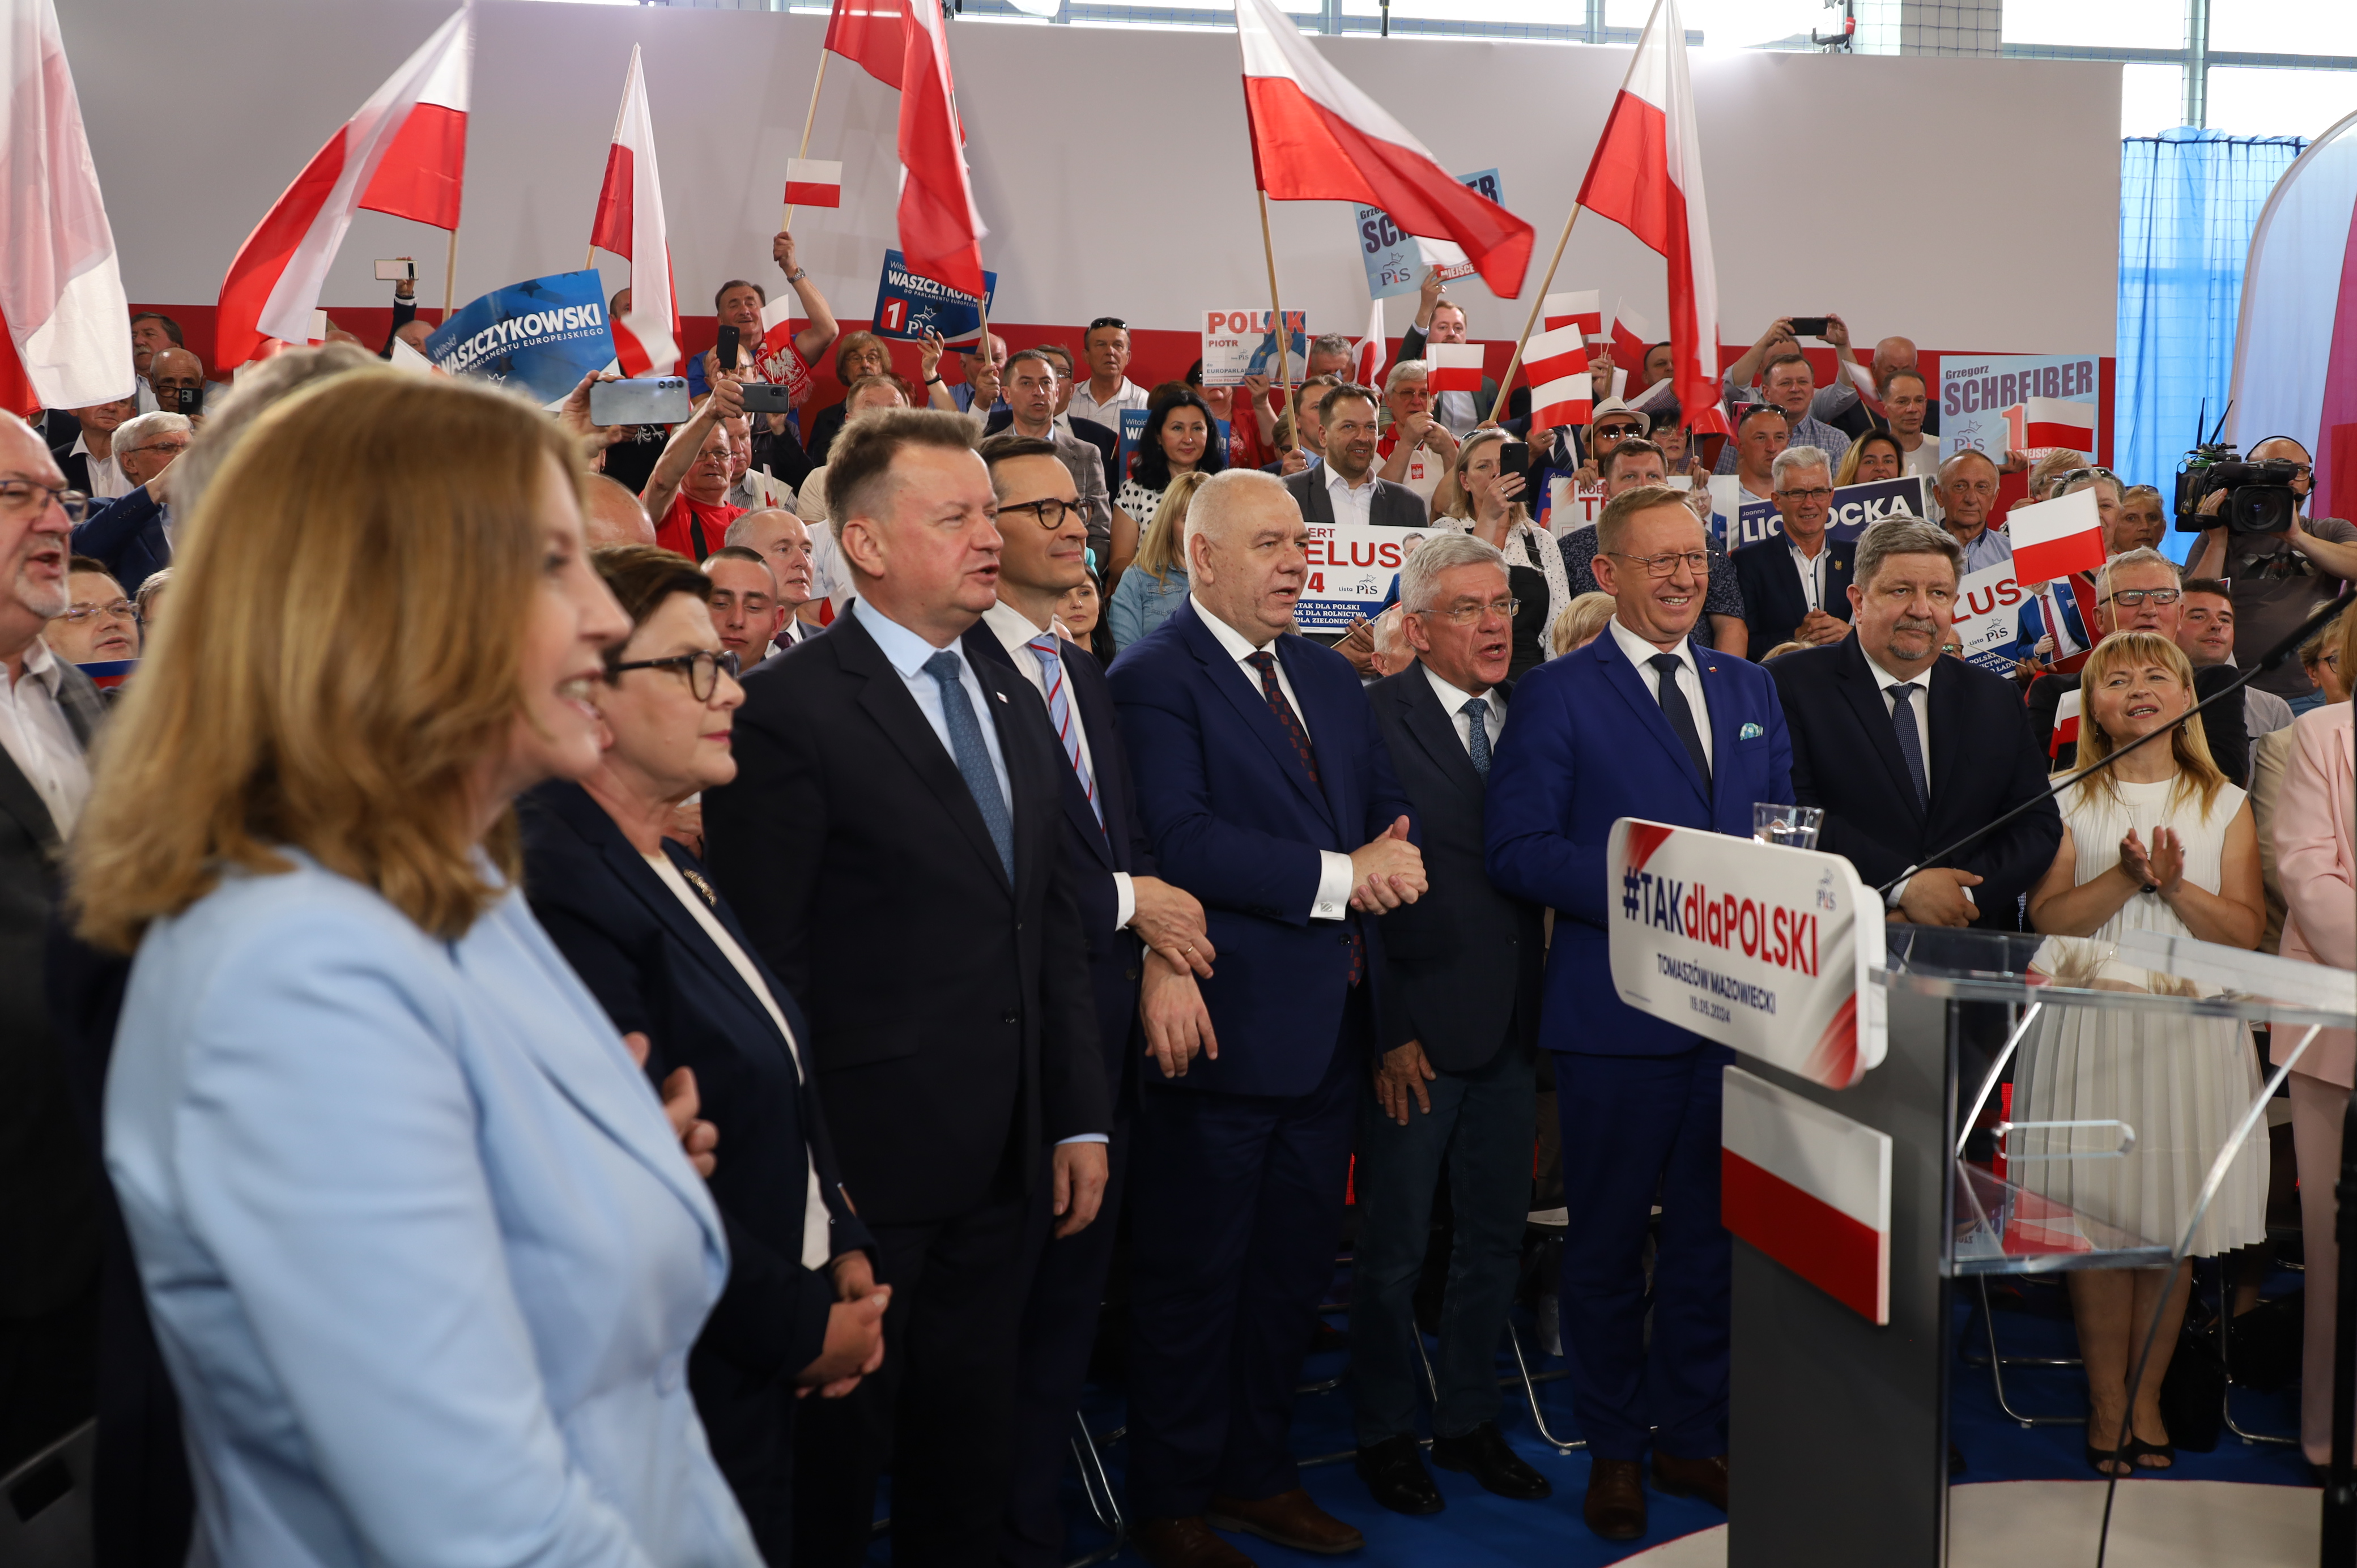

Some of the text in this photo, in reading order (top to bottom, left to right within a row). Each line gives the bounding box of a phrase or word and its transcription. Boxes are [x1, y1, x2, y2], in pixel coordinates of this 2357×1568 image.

[1360, 206, 1385, 220] Grze
[1380, 267, 1411, 286] PiS
[1440, 262, 1475, 279] MIEJSCE
[914, 290, 950, 302] PARLAMENTU
[887, 301, 901, 329] 1
[1208, 311, 1305, 334] POLAK
[436, 302, 602, 376] WASZCZYKOWSKI
[906, 320, 935, 338] PiS
[469, 342, 520, 372] PARLAMENTU
[523, 327, 604, 347] EUROPEJSKIEGO
[1945, 365, 1989, 380] Grzegorz
[1945, 360, 2093, 416] SCHREIBER
[2001, 402, 2026, 451] 1
[1953, 438, 1985, 452] PiS
[1742, 495, 1914, 543] LICOCKA
[1308, 527, 1335, 538] ERT
[1304, 539, 1402, 568] ELUS
[1308, 572, 1325, 593] 4
[1356, 585, 1378, 594] PiS
[1951, 578, 2022, 624] LUS
[1985, 627, 2008, 642] PiS
[1968, 651, 1996, 664] POLSKI
[1996, 660, 2016, 672] ŁADU
[1622, 866, 1819, 978] #TAKdlaPOLSKI
[1656, 952, 1776, 1016] TOMASZÓW MAZOWIECKI
